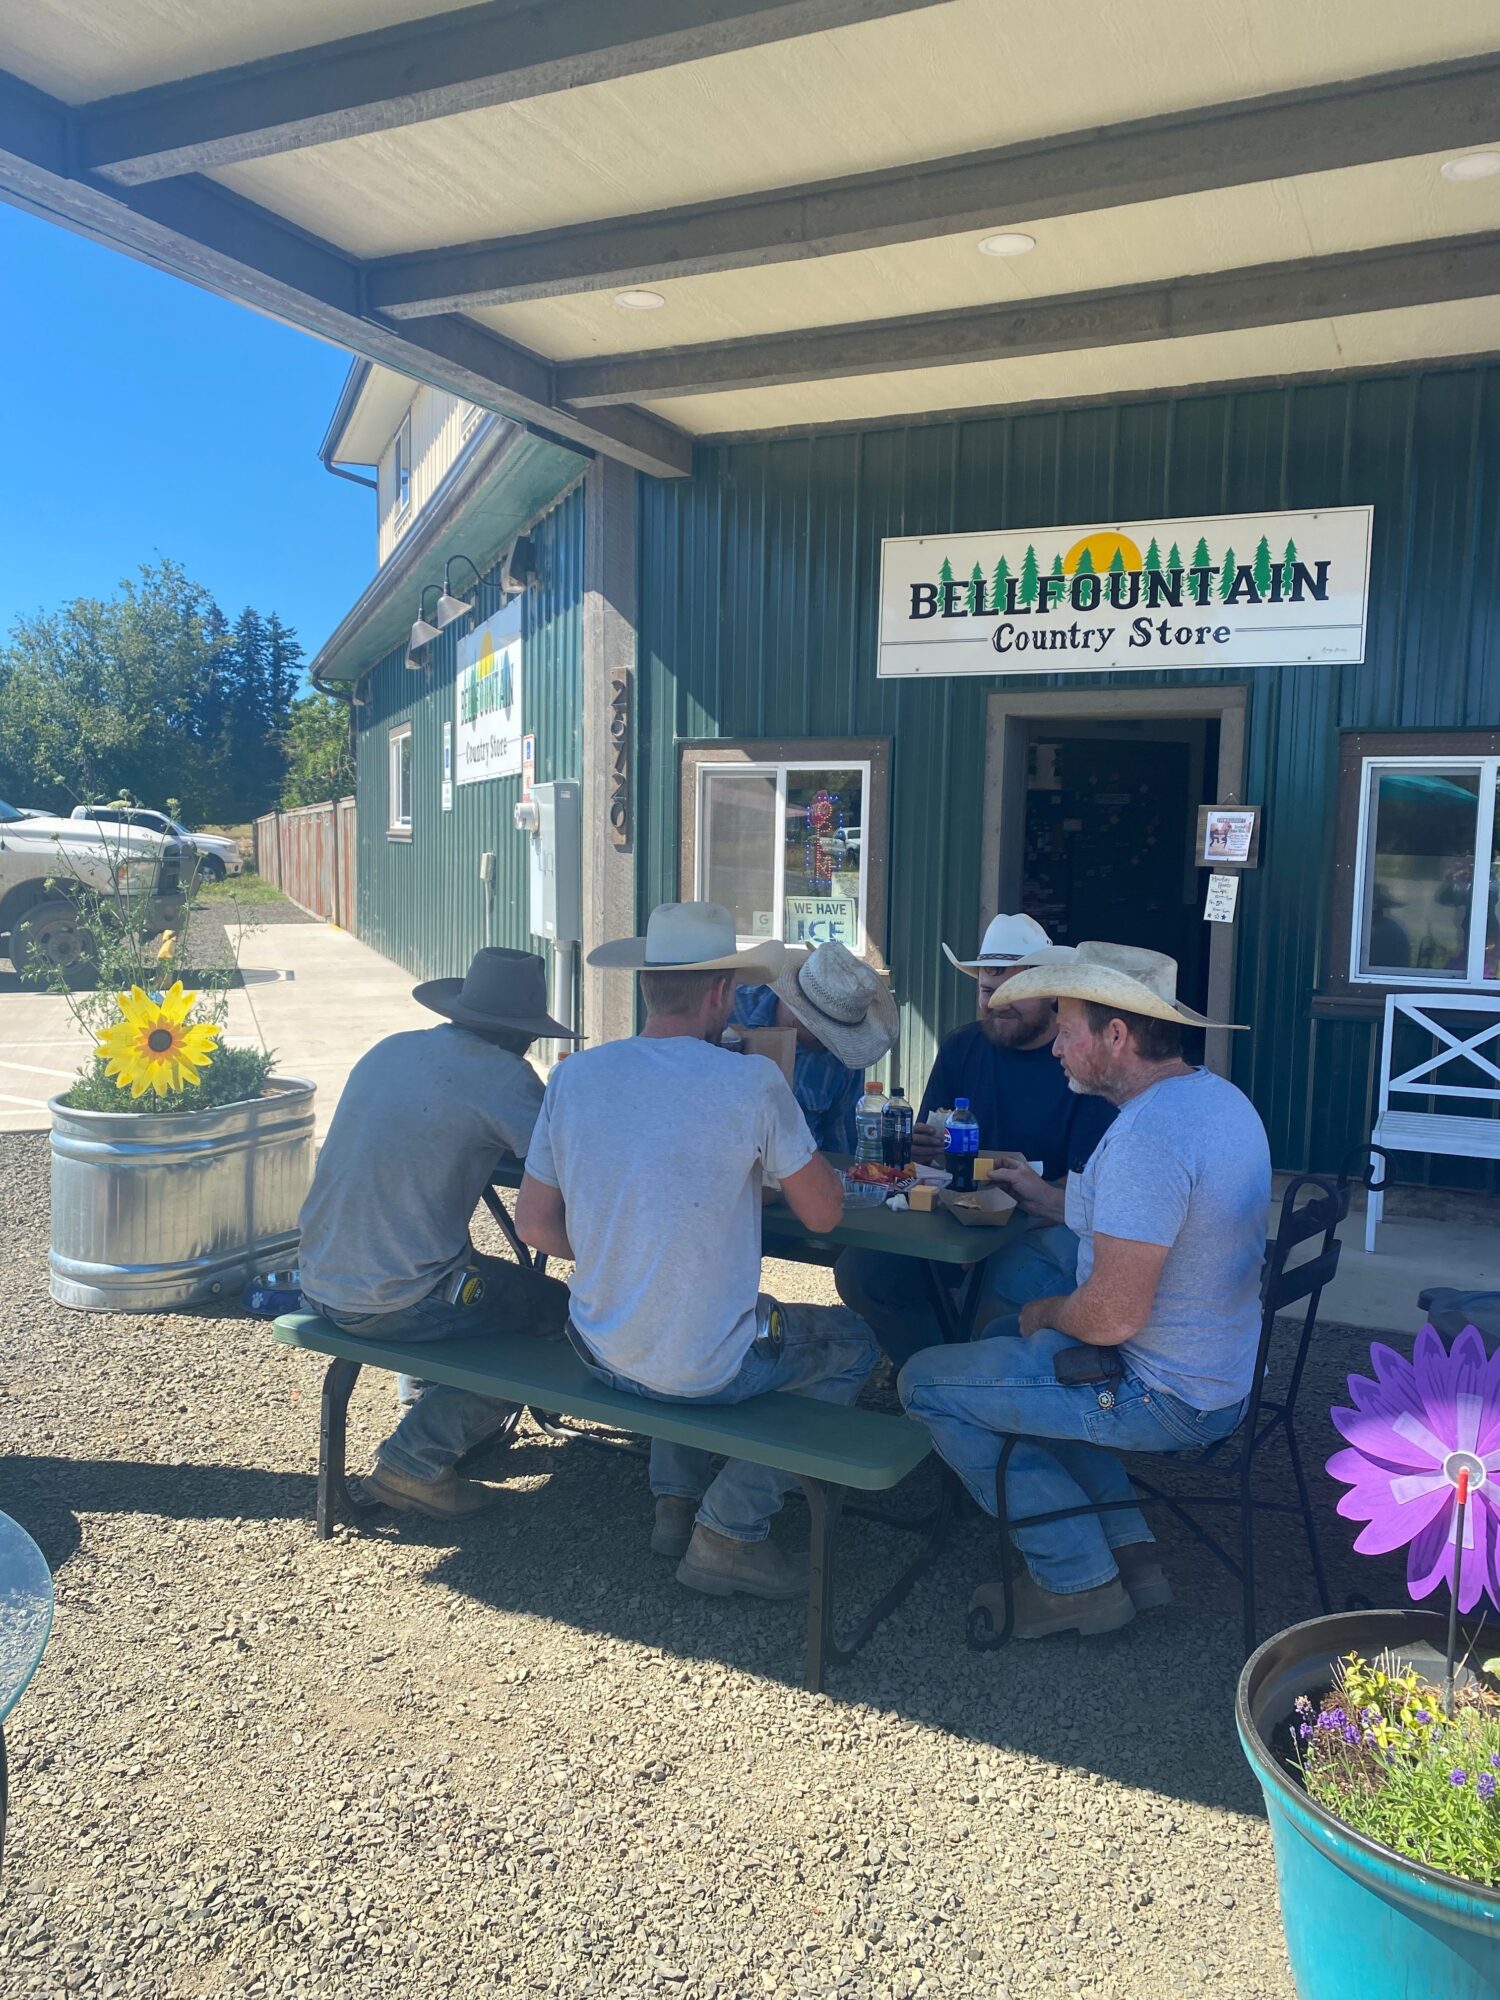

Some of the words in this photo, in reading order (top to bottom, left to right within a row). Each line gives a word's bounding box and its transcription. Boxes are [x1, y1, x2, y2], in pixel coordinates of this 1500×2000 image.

[908, 561, 1331, 619] BELLFOUNTAIN
[992, 622, 1115, 654] Country
[1129, 617, 1231, 649] Store
[466, 738, 490, 768] Country
[490, 733, 508, 760] Store
[759, 914, 769, 925] G
[794, 903, 813, 914] WE
[816, 903, 847, 915] HAVE
[797, 920, 845, 943] ICE
